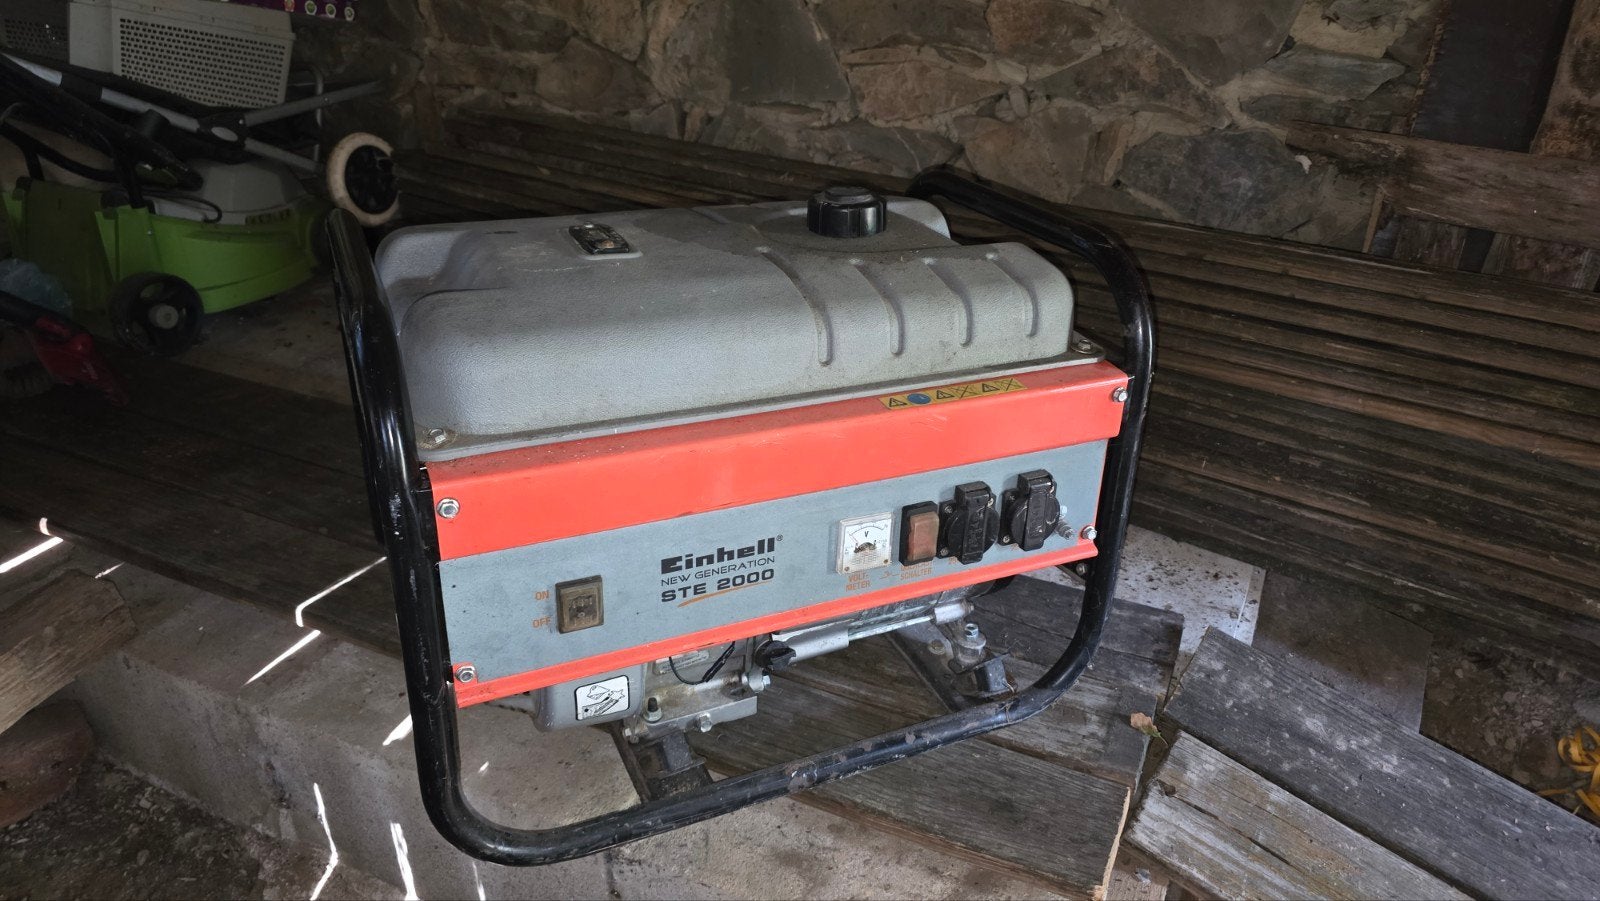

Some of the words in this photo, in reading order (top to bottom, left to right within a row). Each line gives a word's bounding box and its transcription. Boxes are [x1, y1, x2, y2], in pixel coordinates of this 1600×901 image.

[661, 573, 691, 586] NEW
[695, 556, 775, 579] GENERATION
[661, 583, 706, 602] STE
[717, 568, 774, 590] 2000
[845, 580, 871, 592] METER
[535, 590, 549, 600] ON
[532, 617, 550, 628] OFF
